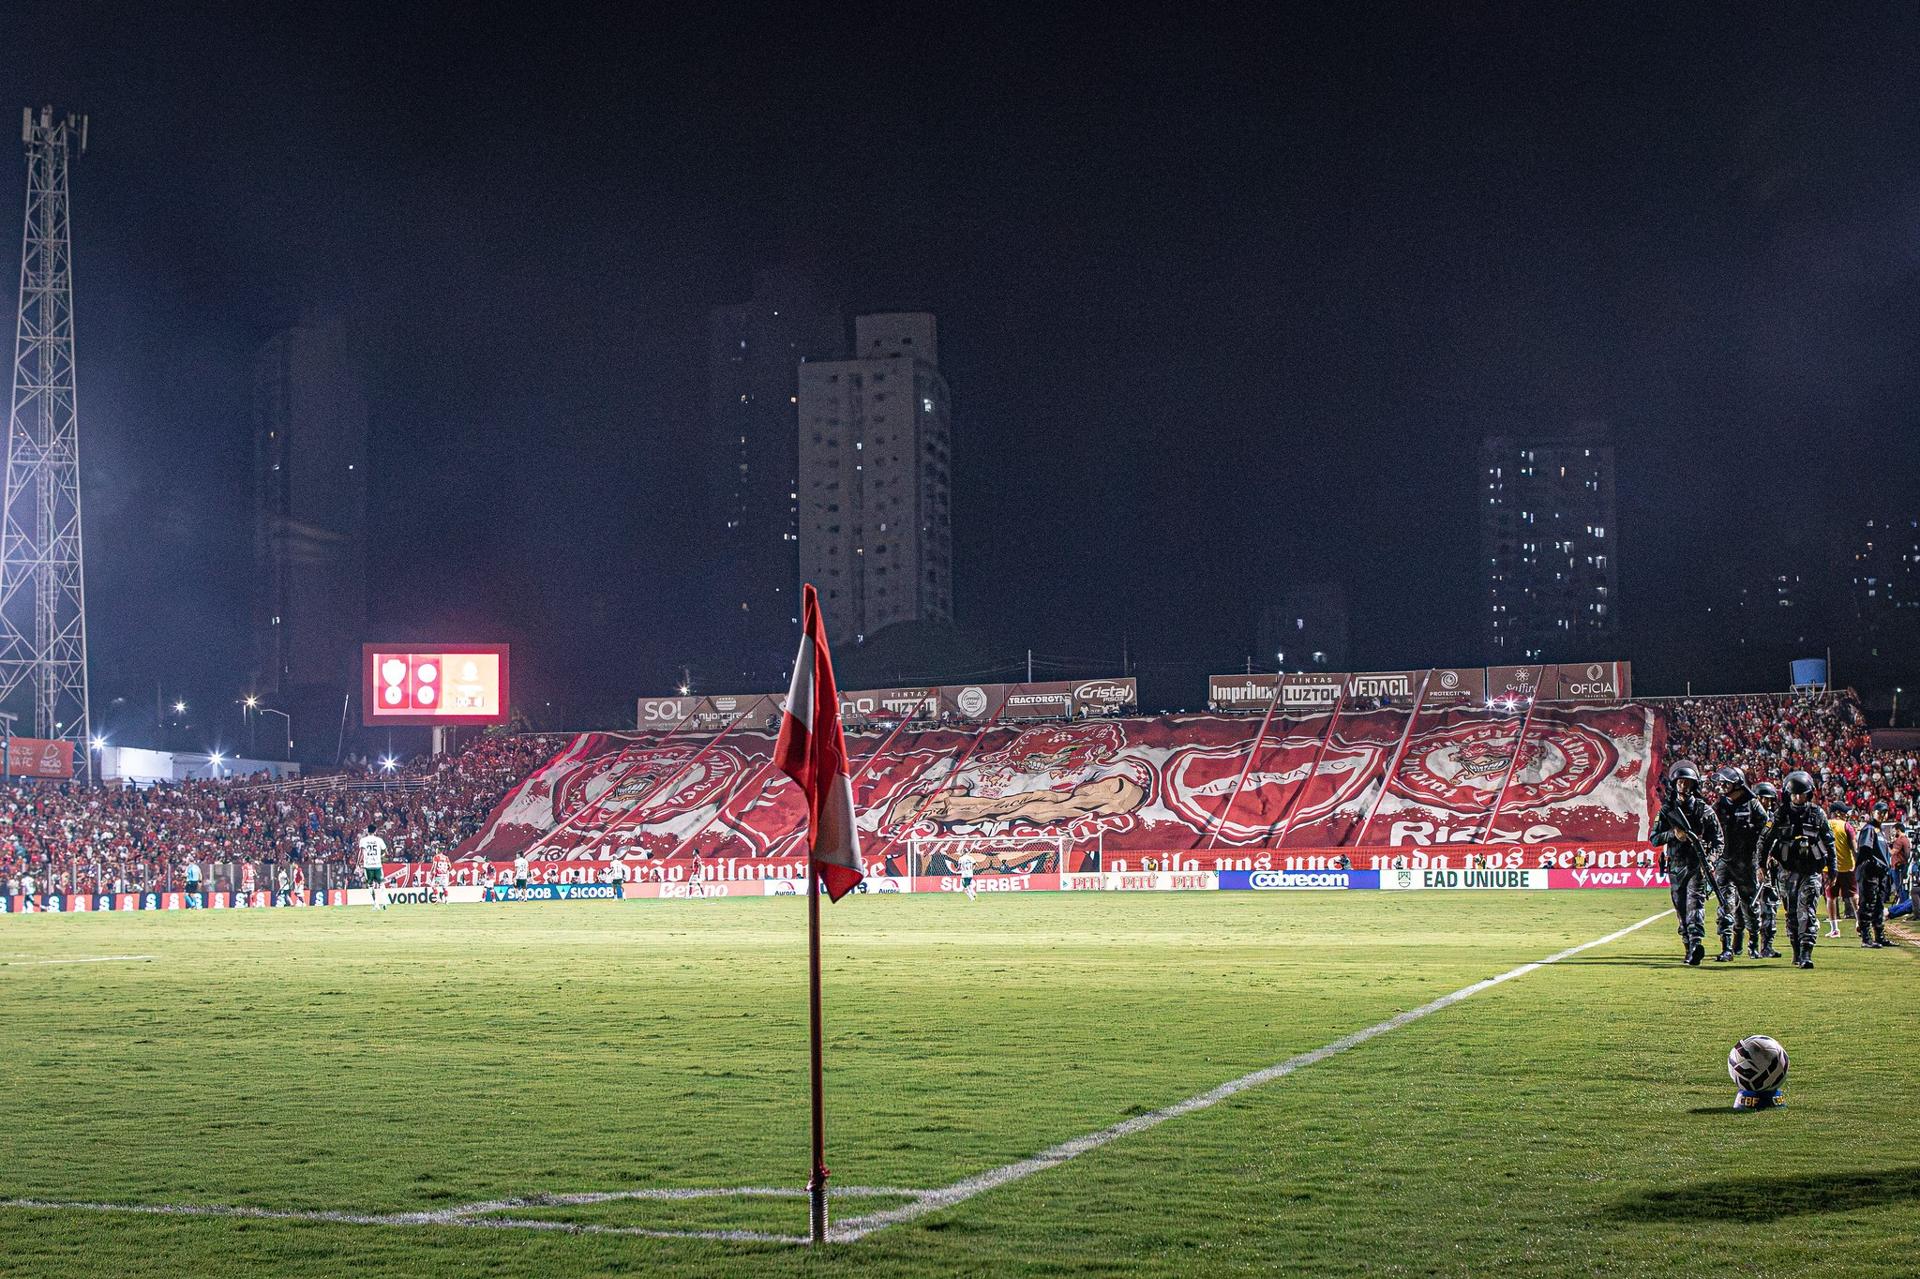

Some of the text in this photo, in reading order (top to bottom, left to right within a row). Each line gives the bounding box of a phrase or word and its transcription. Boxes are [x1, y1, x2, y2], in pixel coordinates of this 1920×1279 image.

[1080, 685, 1129, 698] Cristal
[1285, 687, 1339, 702] LUZTOL
[1350, 679, 1413, 697] VEDACIL
[1571, 683, 1616, 694] OFICIA
[644, 701, 688, 720] SOL
[1198, 779, 1238, 794] VILA
[1213, 852, 1273, 871] nos
[1423, 871, 1530, 888] EAD UNIUBE
[1590, 872, 1632, 884] VOLT
[570, 886, 614, 899] SICOOB
